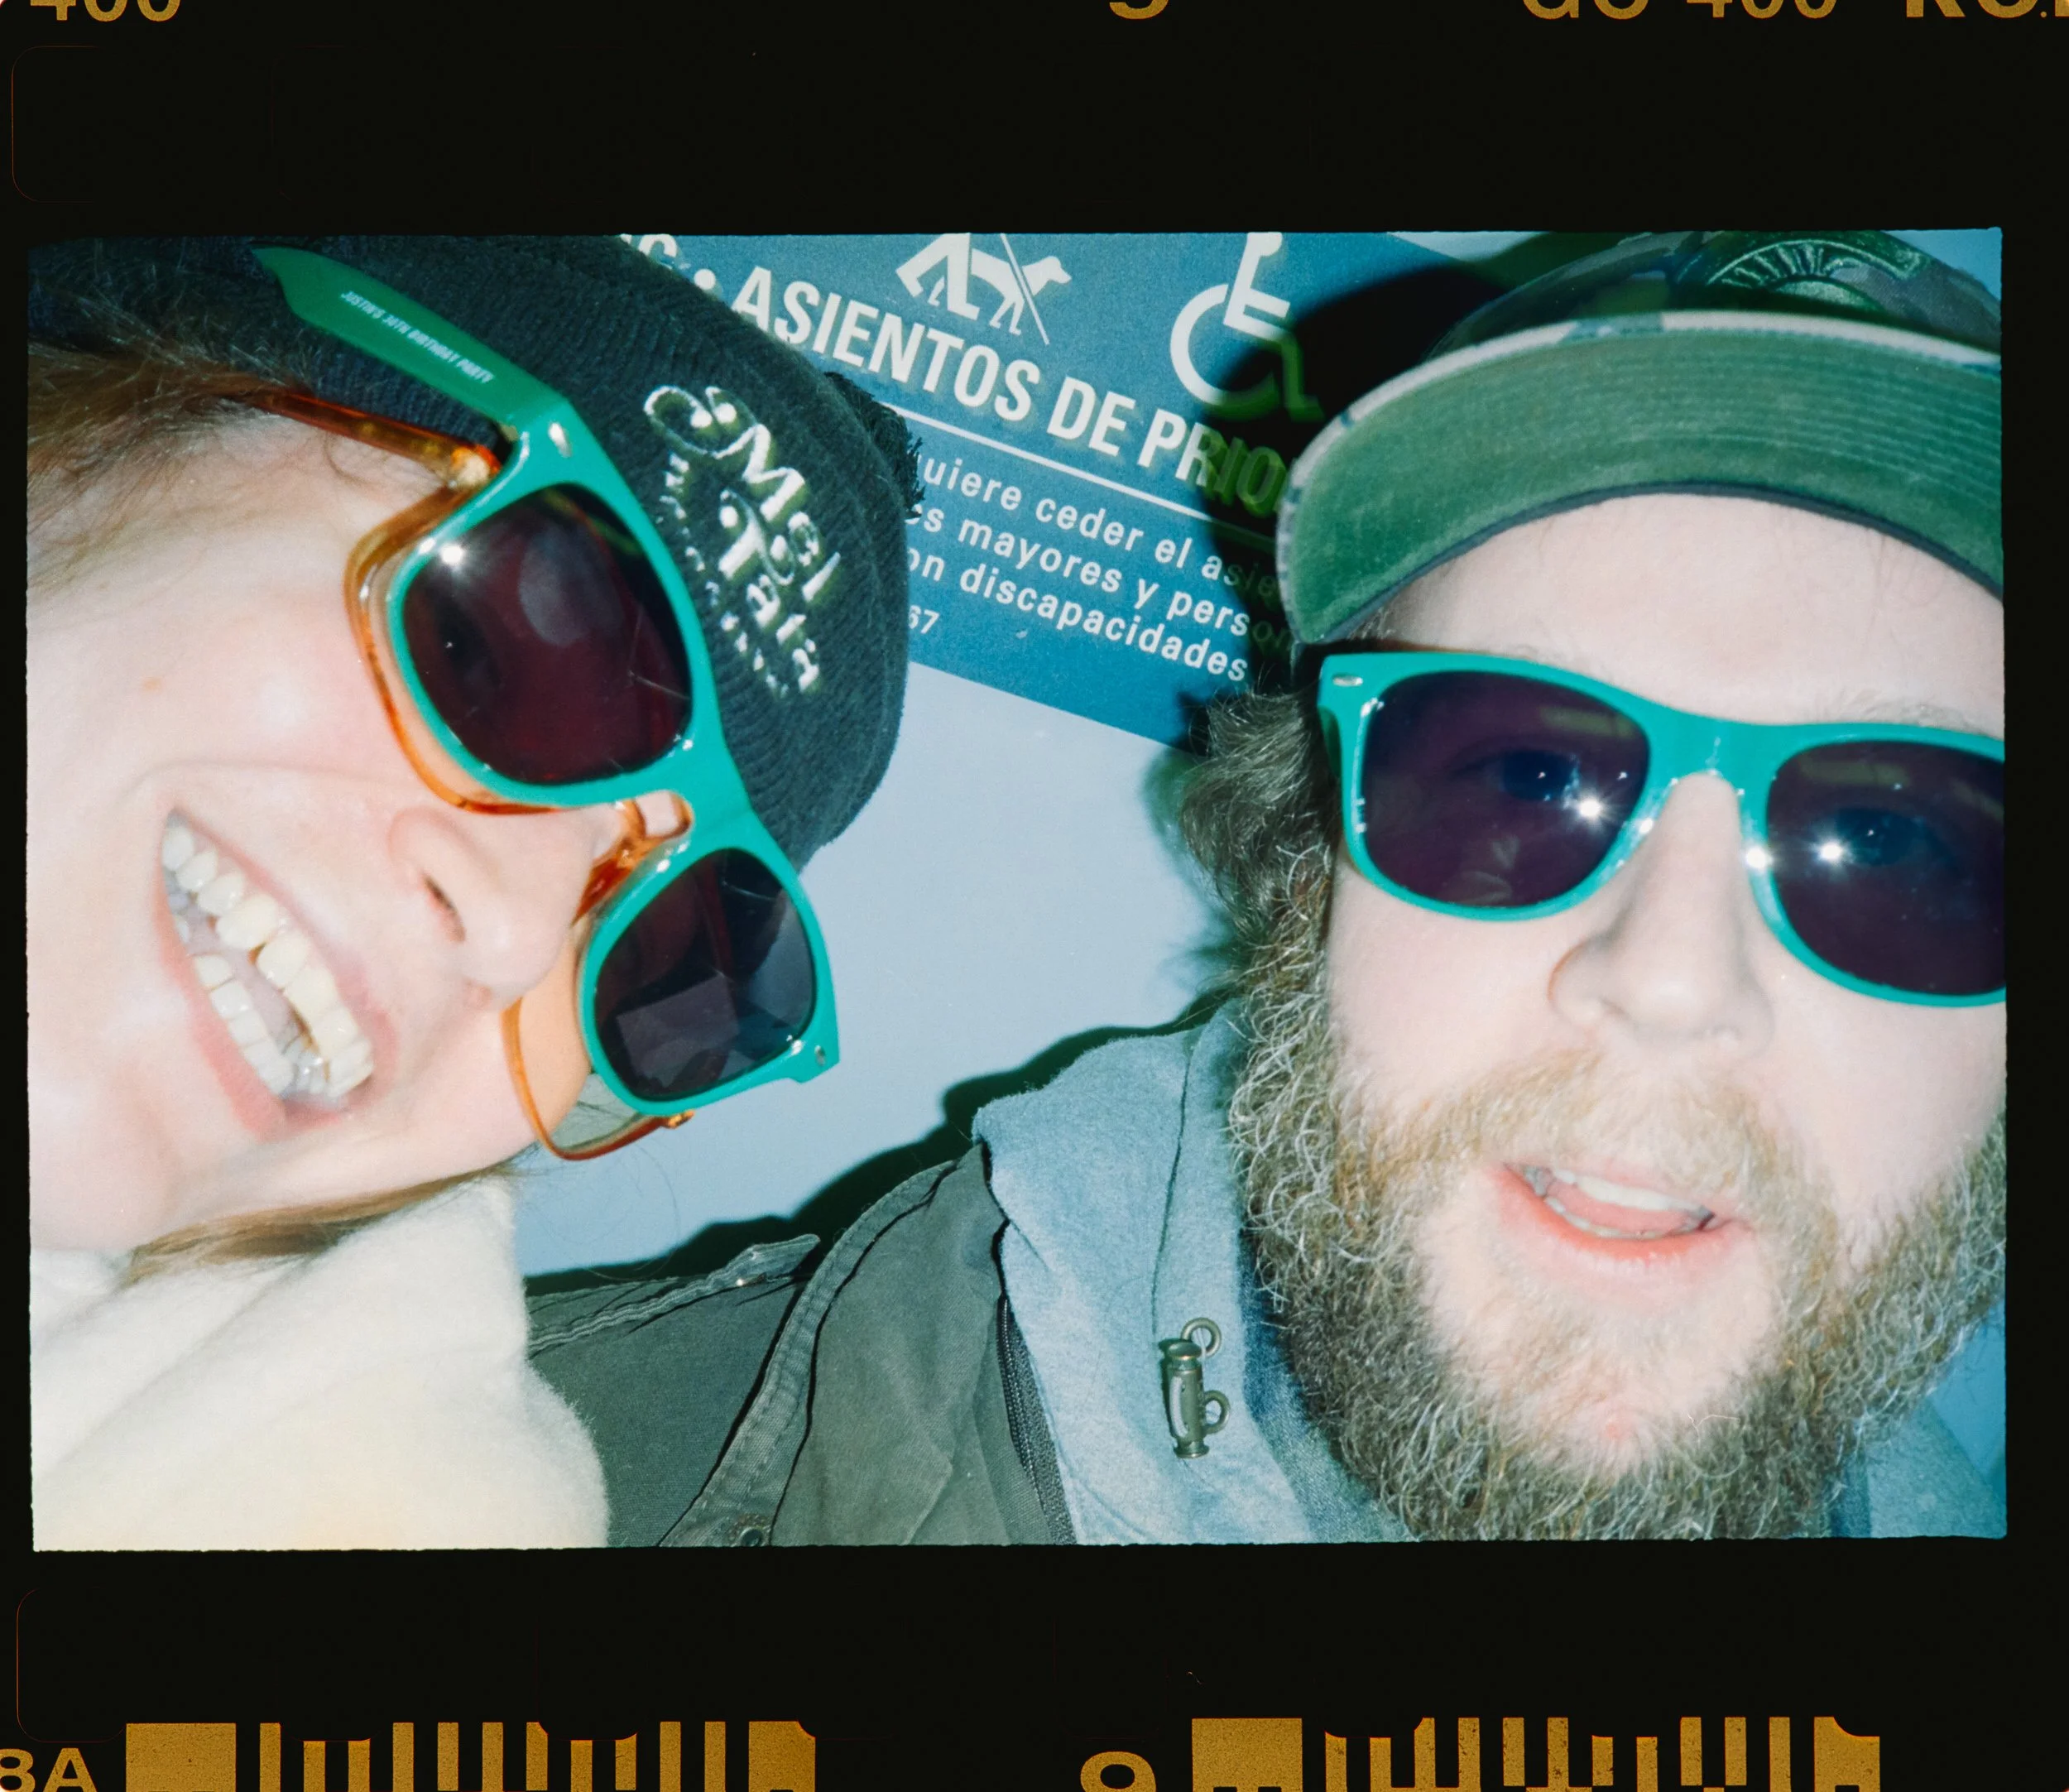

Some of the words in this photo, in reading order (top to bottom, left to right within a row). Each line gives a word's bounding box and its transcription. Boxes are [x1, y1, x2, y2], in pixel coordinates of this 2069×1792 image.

[732, 266, 1040, 421] ASIENTOS
[1046, 376, 1137, 457] DE
[1136, 408, 1288, 511] PRIO
[919, 453, 1022, 511] uiere
[1035, 497, 1145, 551] ceder
[1155, 536, 1193, 569] el
[957, 518, 1123, 593] mayores
[1134, 578, 1160, 611] y
[959, 563, 1249, 682] discapacidades
